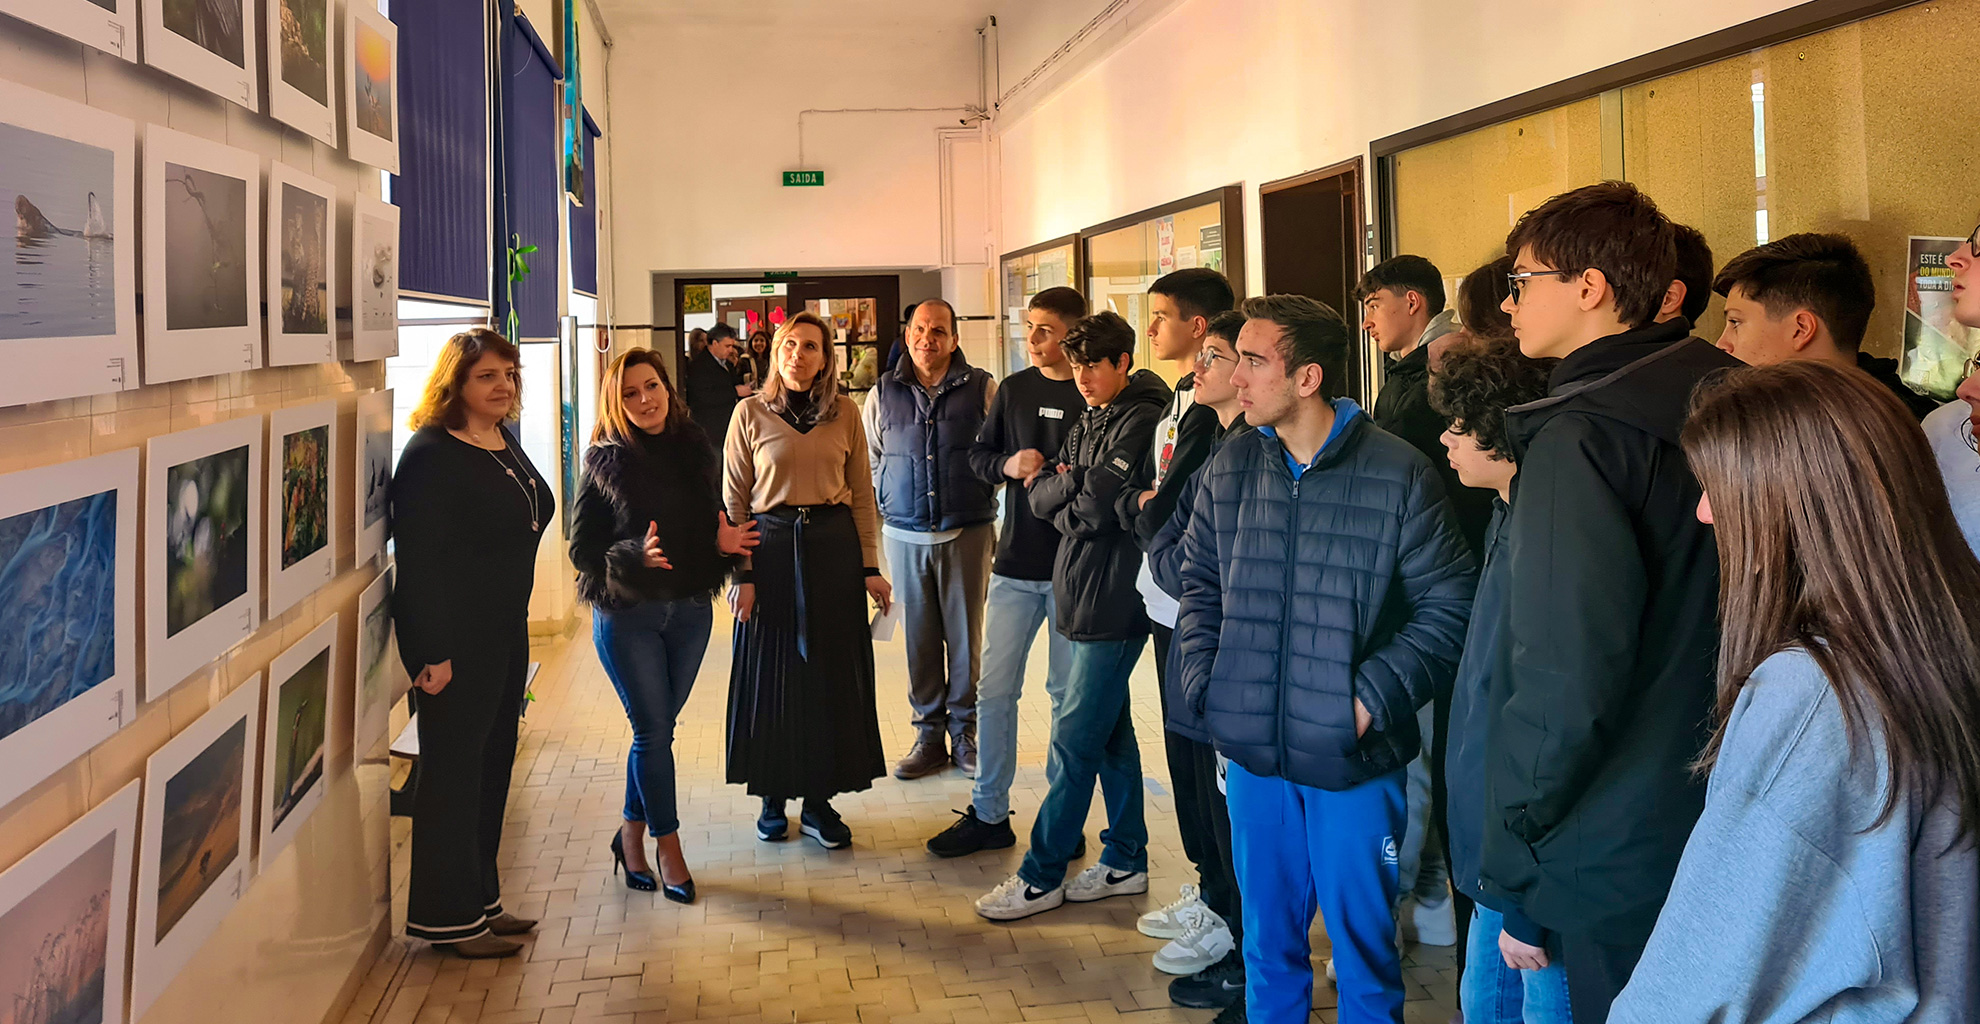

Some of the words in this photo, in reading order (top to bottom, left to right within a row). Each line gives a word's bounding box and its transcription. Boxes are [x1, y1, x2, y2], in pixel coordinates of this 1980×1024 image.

[1920, 253, 1937, 264] ESTE
[1938, 252, 1943, 264] É
[1931, 267, 1956, 278] MUNDO
[1920, 278, 1937, 289] TODA
